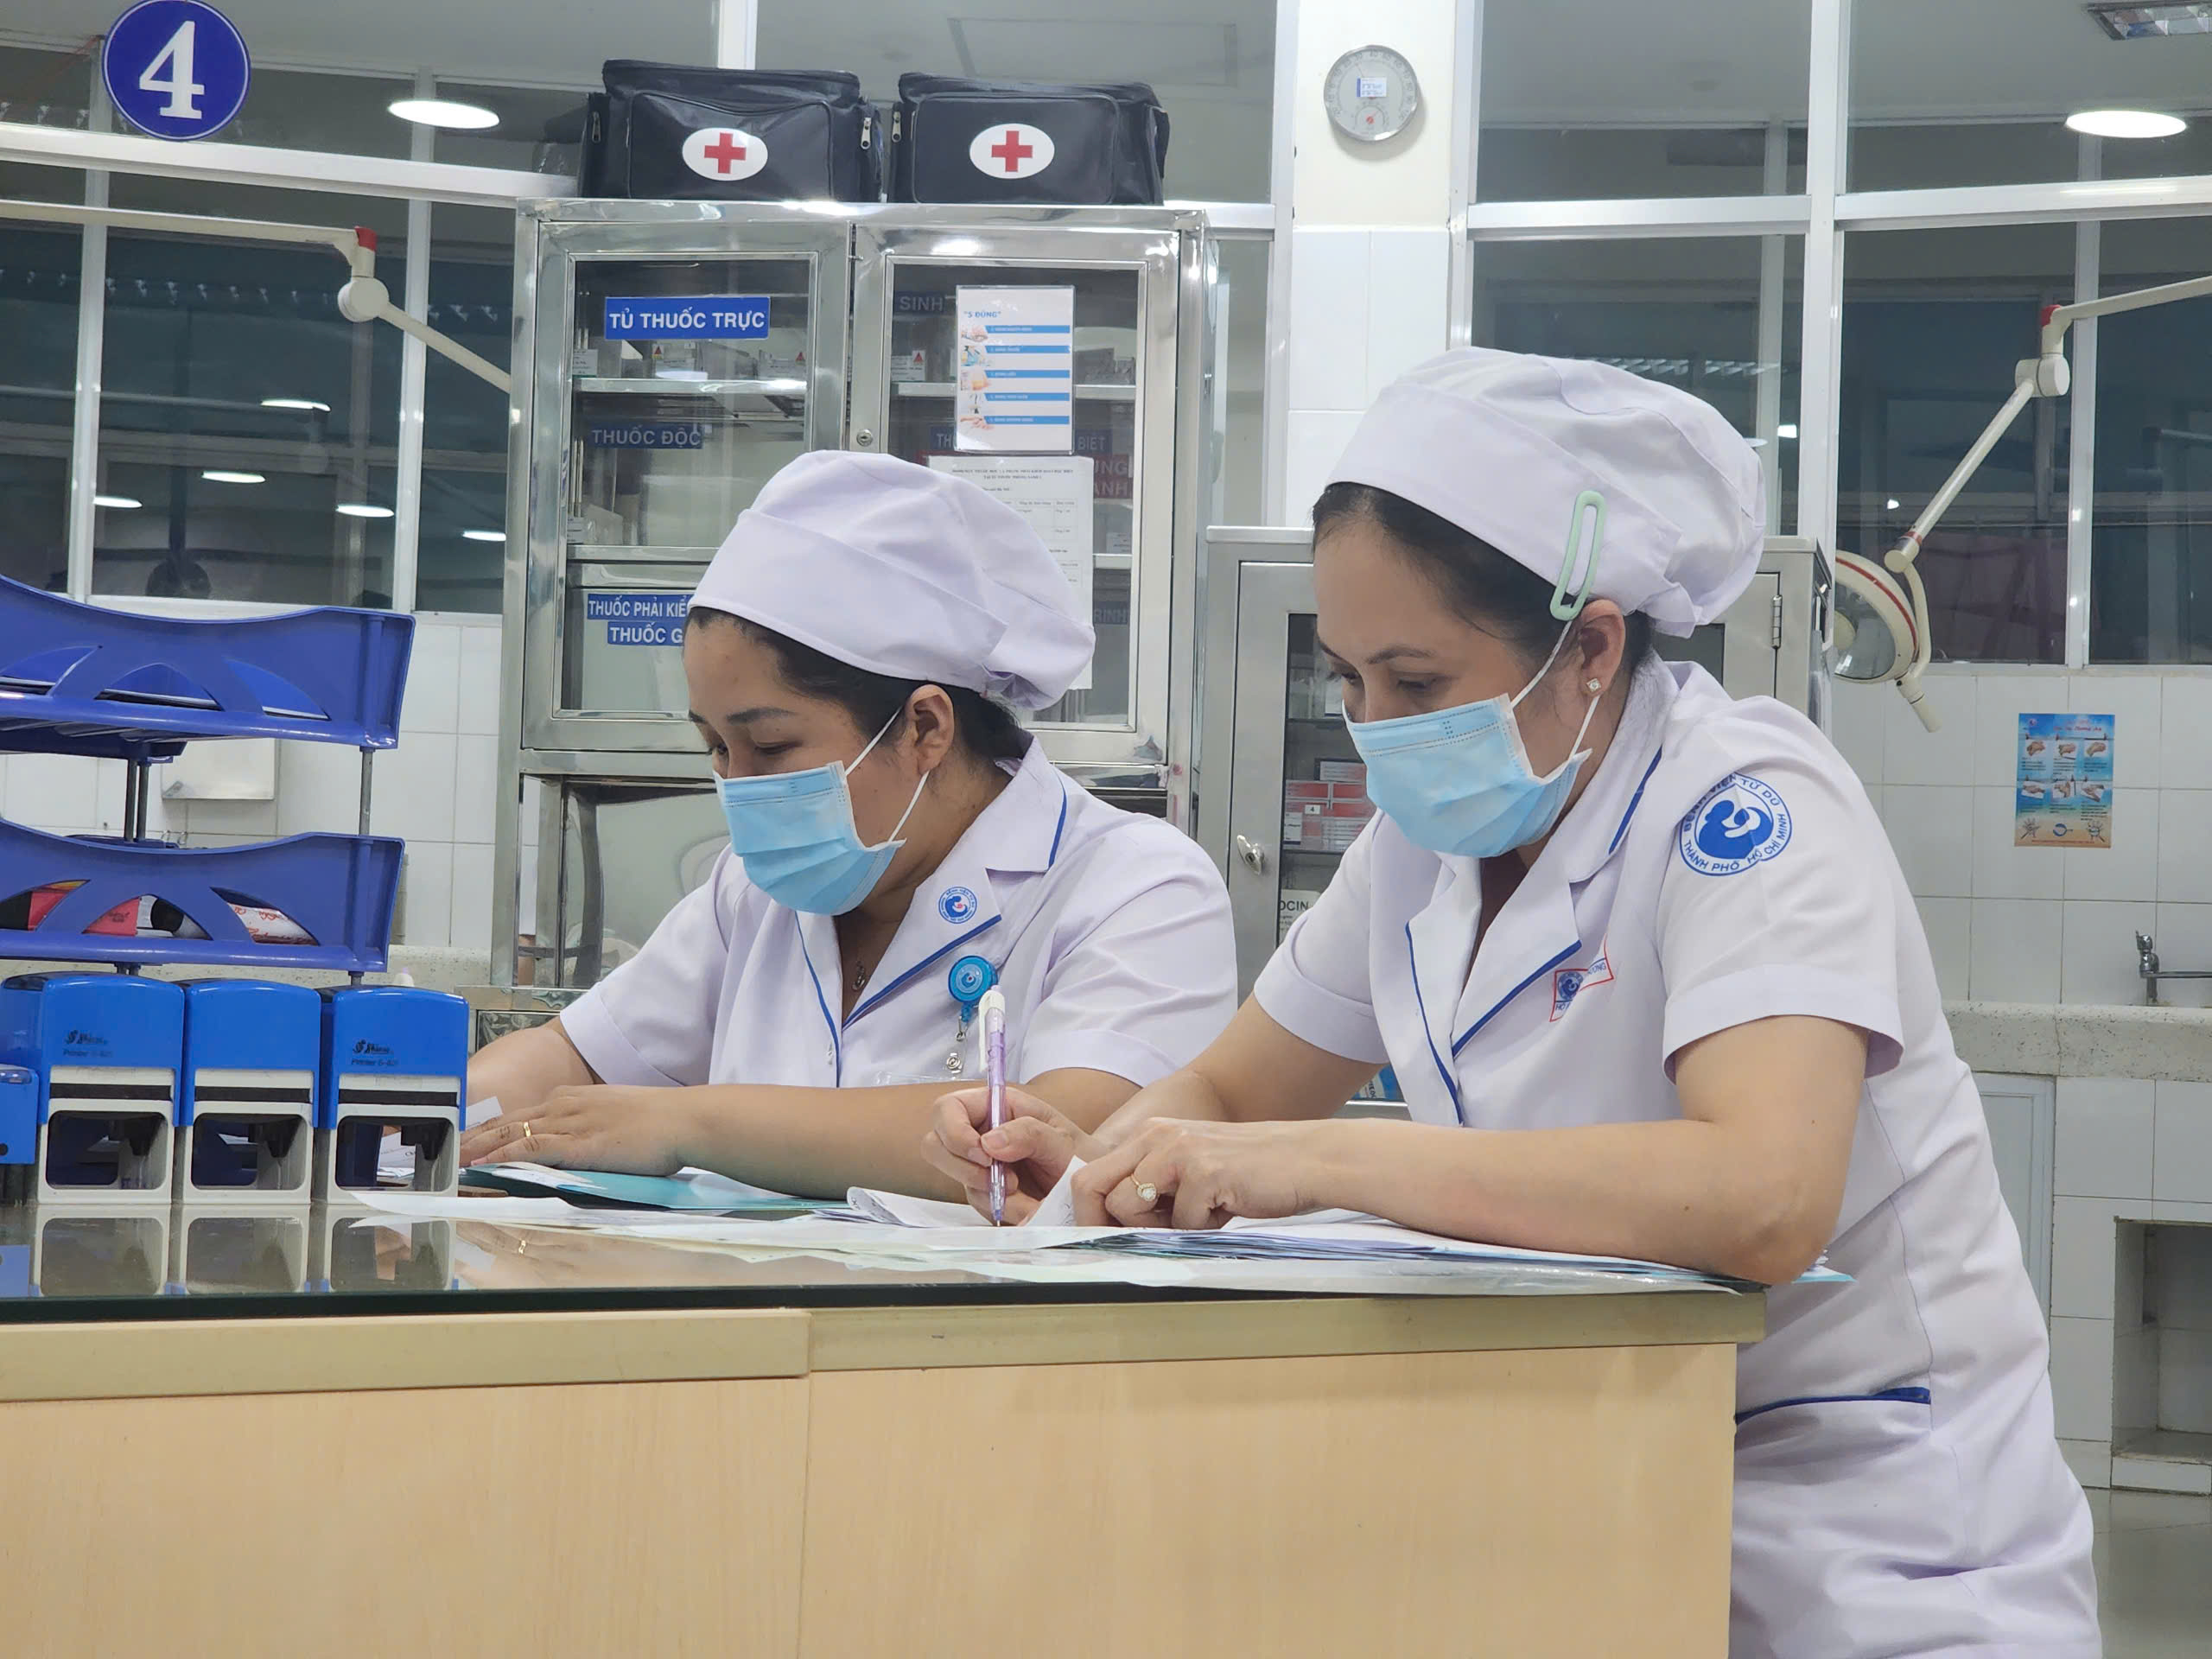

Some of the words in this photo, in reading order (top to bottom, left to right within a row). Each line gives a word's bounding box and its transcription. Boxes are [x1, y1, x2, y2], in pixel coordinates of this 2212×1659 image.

[139, 21, 205, 119] 4
[899, 296, 944, 312] SINH
[608, 307, 633, 329] TỦ
[639, 306, 706, 329] THUỐC
[712, 310, 765, 331] TRỰC
[592, 424, 655, 446] THUỐC
[661, 426, 702, 447] ĐỘC
[588, 594, 630, 617] THUỐC
[633, 596, 663, 617] PHẢI
[666, 594, 688, 618] KIỂ
[610, 621, 665, 644] THUỐC
[671, 627, 684, 644] G
[1684, 839, 1709, 869] THÀNH
[1711, 859, 1740, 871] PHỐ
[1777, 813, 1787, 840] MINH
